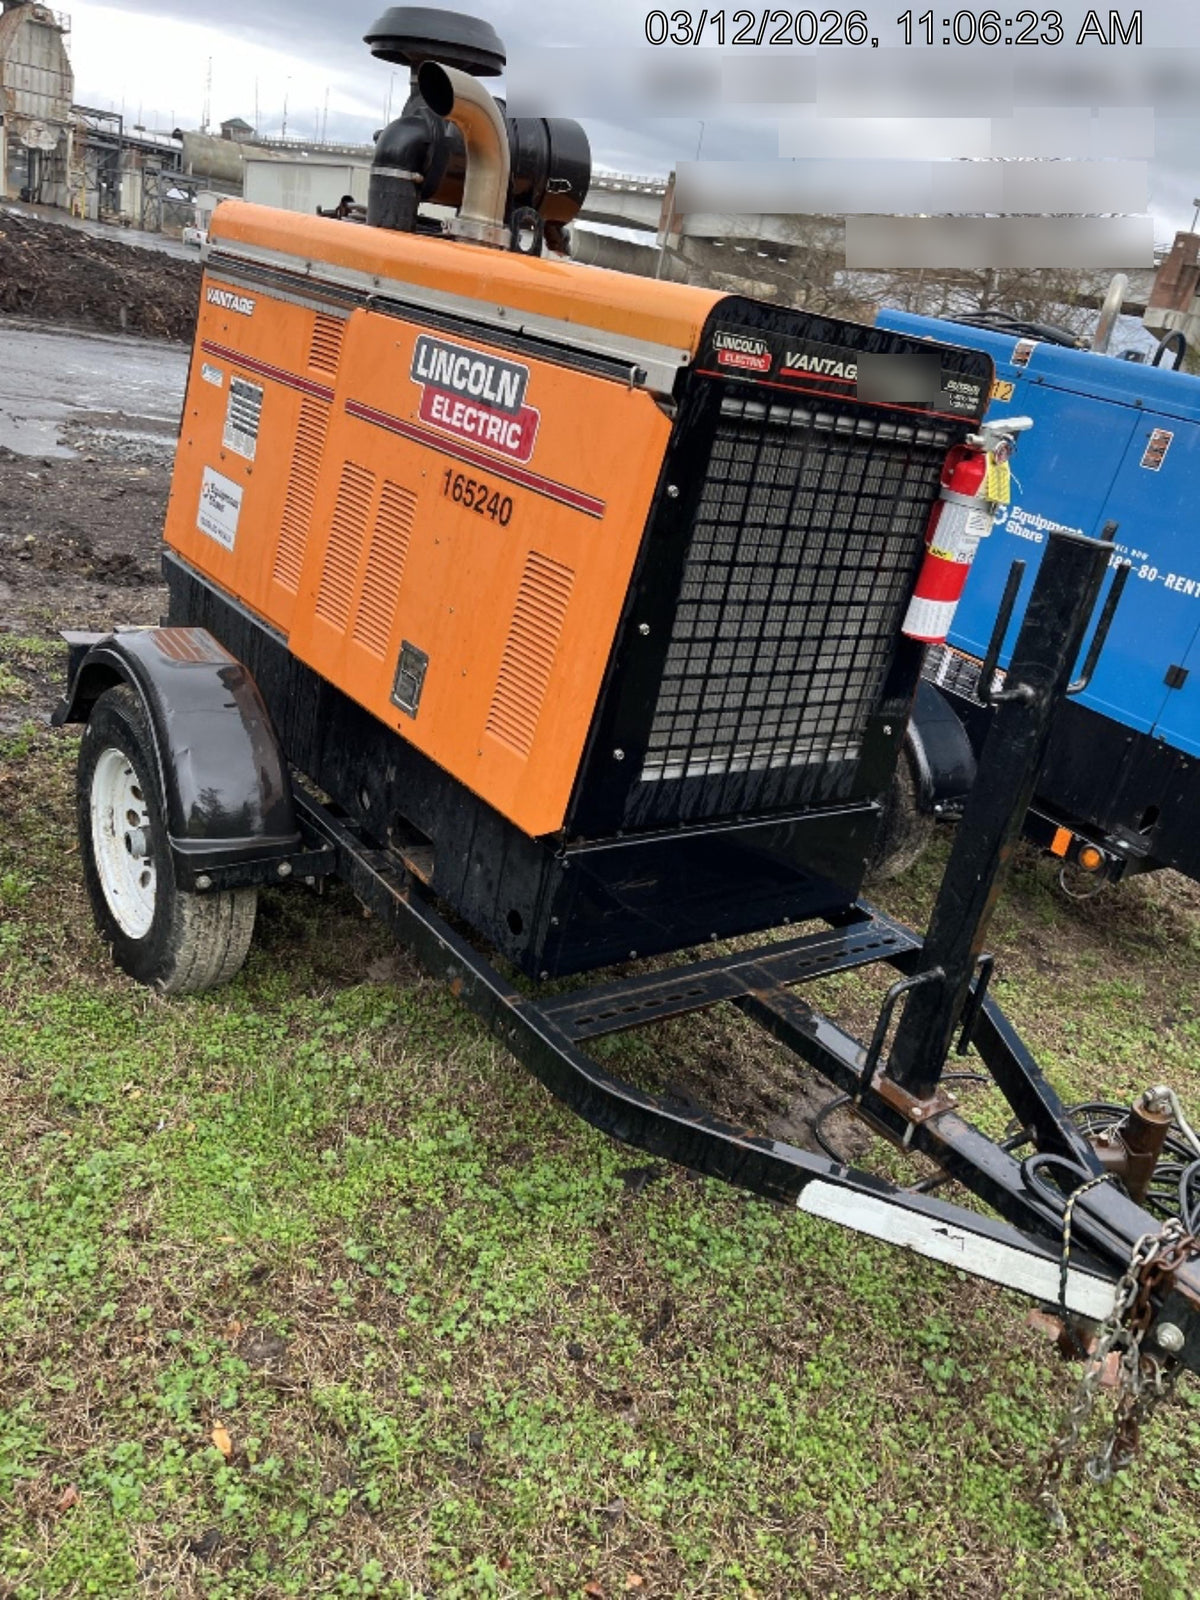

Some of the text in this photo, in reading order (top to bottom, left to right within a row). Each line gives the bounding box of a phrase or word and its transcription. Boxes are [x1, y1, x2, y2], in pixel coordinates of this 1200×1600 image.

[206, 287, 256, 317] VANTAGE
[715, 334, 764, 356] LINCOLN
[416, 344, 520, 408] LINCOLN
[724, 352, 766, 370] ELECTRIC
[784, 351, 858, 381] VANTAG
[430, 394, 522, 449] ELECTRIC
[443, 469, 513, 527] 165240
[1005, 520, 1044, 543] Share
